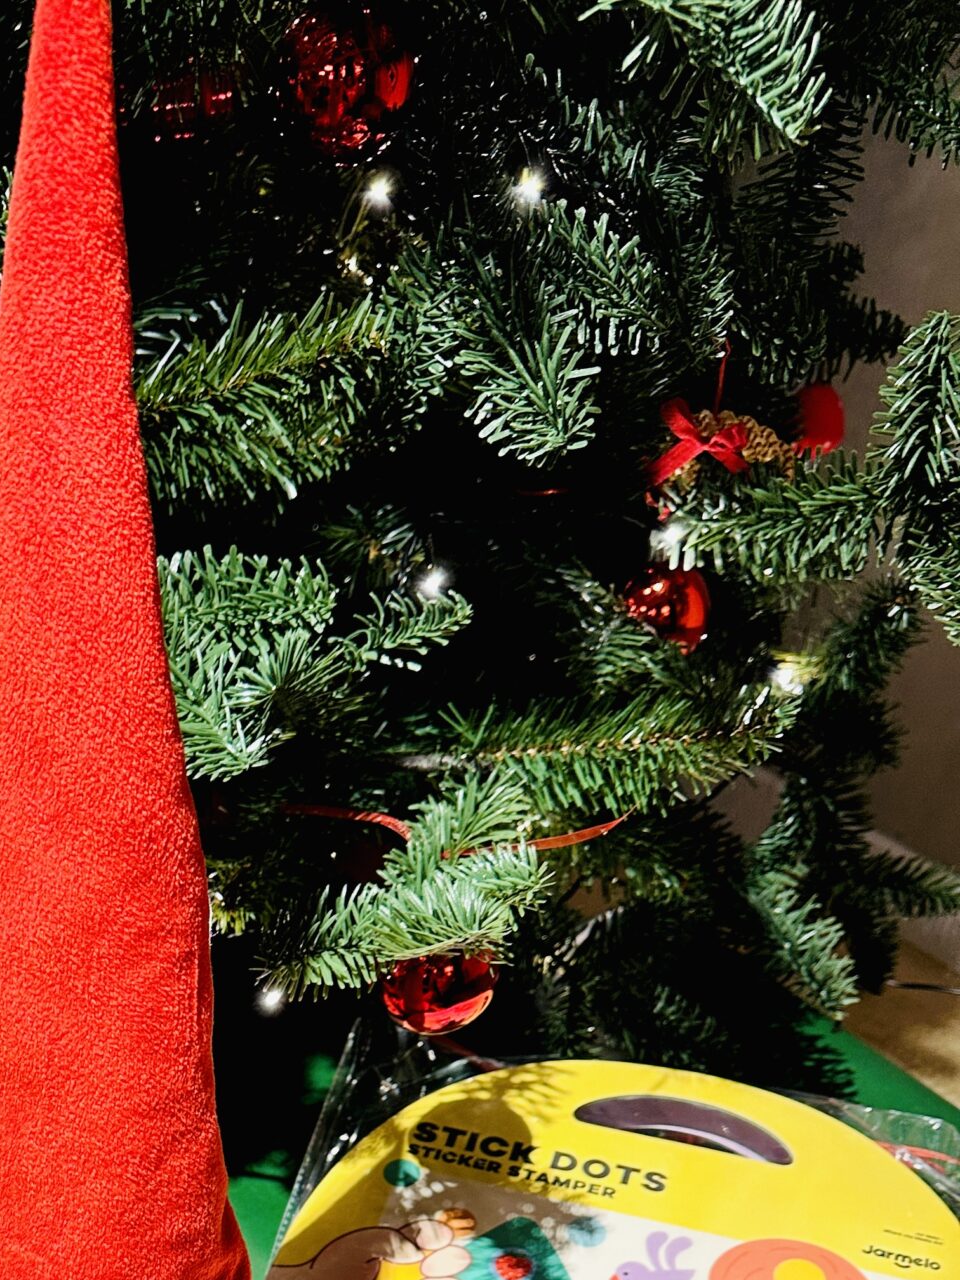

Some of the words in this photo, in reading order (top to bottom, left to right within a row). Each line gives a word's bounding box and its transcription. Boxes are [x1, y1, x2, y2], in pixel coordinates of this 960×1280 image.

[407, 1143, 502, 1174] STICKER
[506, 1165, 617, 1199] STAMPER
[412, 1121, 540, 1165] STICK
[550, 1151, 669, 1192] DOTS
